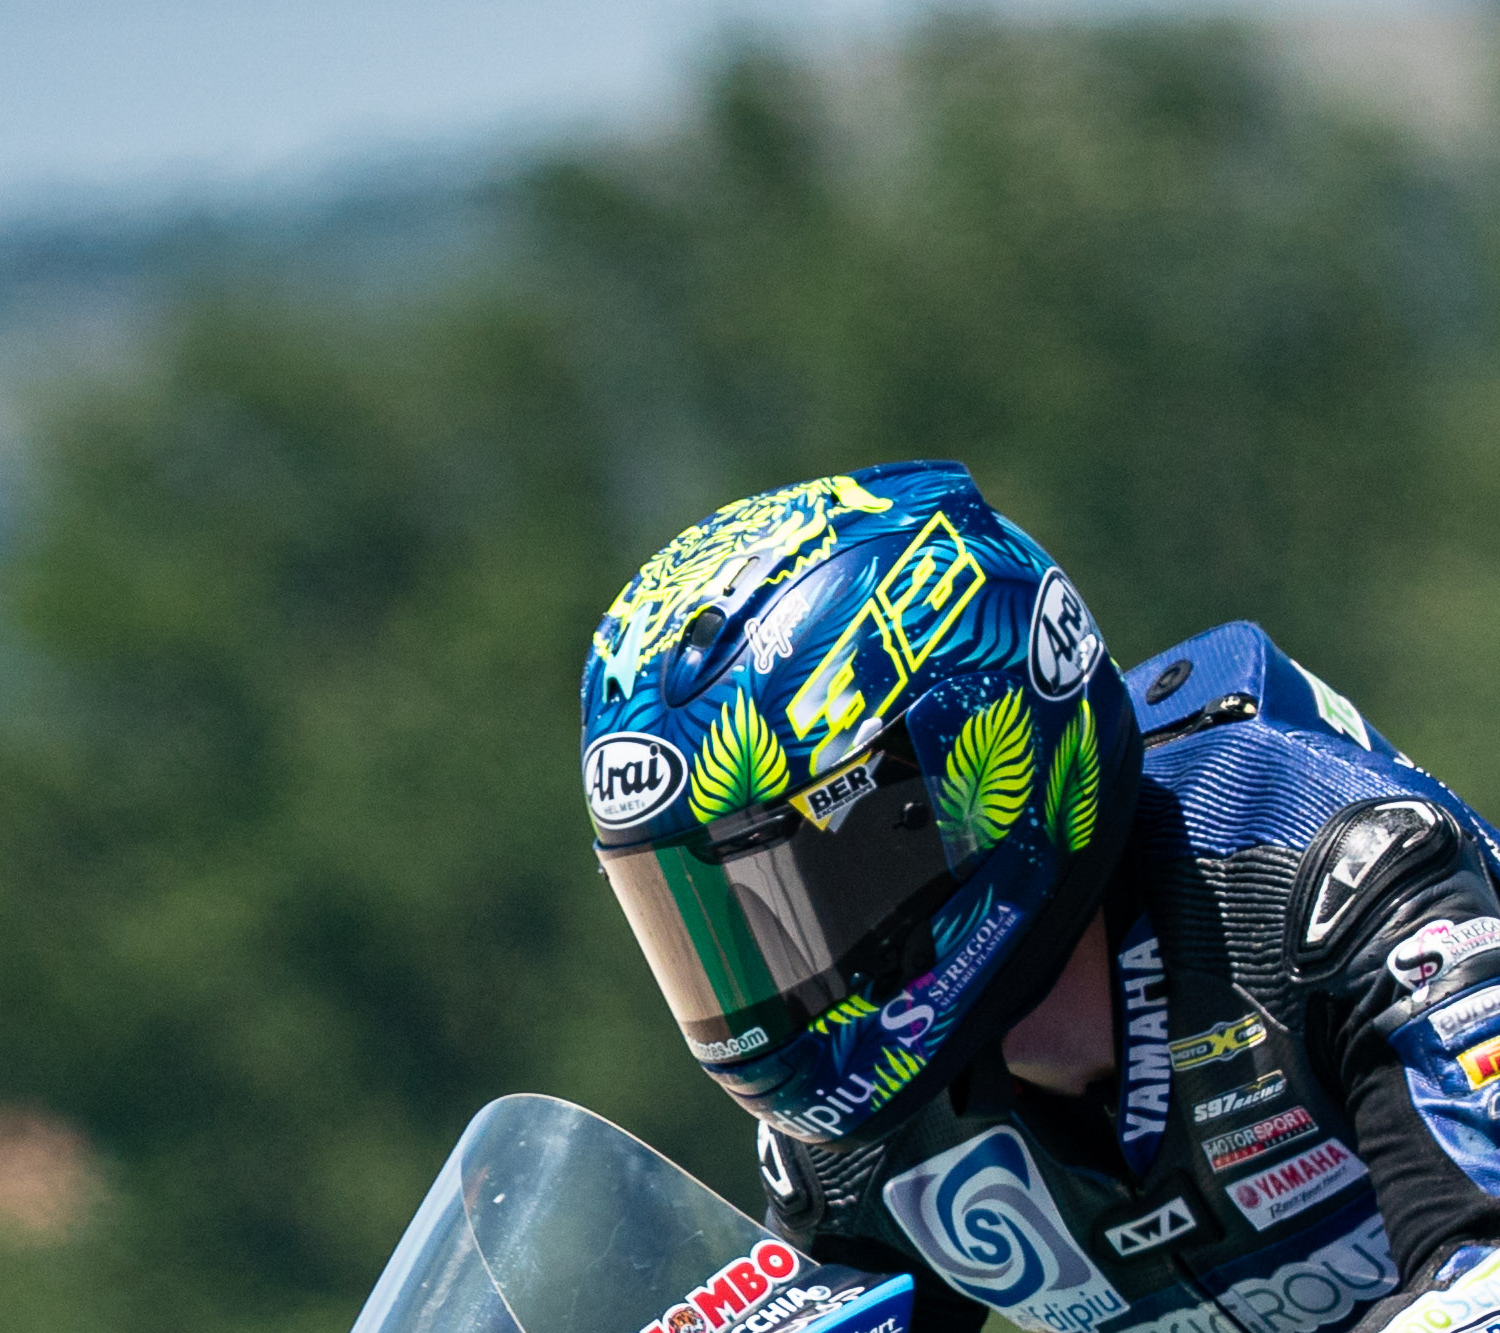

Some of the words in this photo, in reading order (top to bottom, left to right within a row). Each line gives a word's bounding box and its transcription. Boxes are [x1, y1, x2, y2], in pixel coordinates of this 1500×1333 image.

[590, 743, 664, 802] Arai
[807, 766, 871, 814] BER
[928, 903, 1011, 1003] SFREGOLA
[1122, 937, 1171, 1143] YAMAHA
[773, 1073, 875, 1137] dipiu
[1255, 1144, 1348, 1199] YAMAHA
